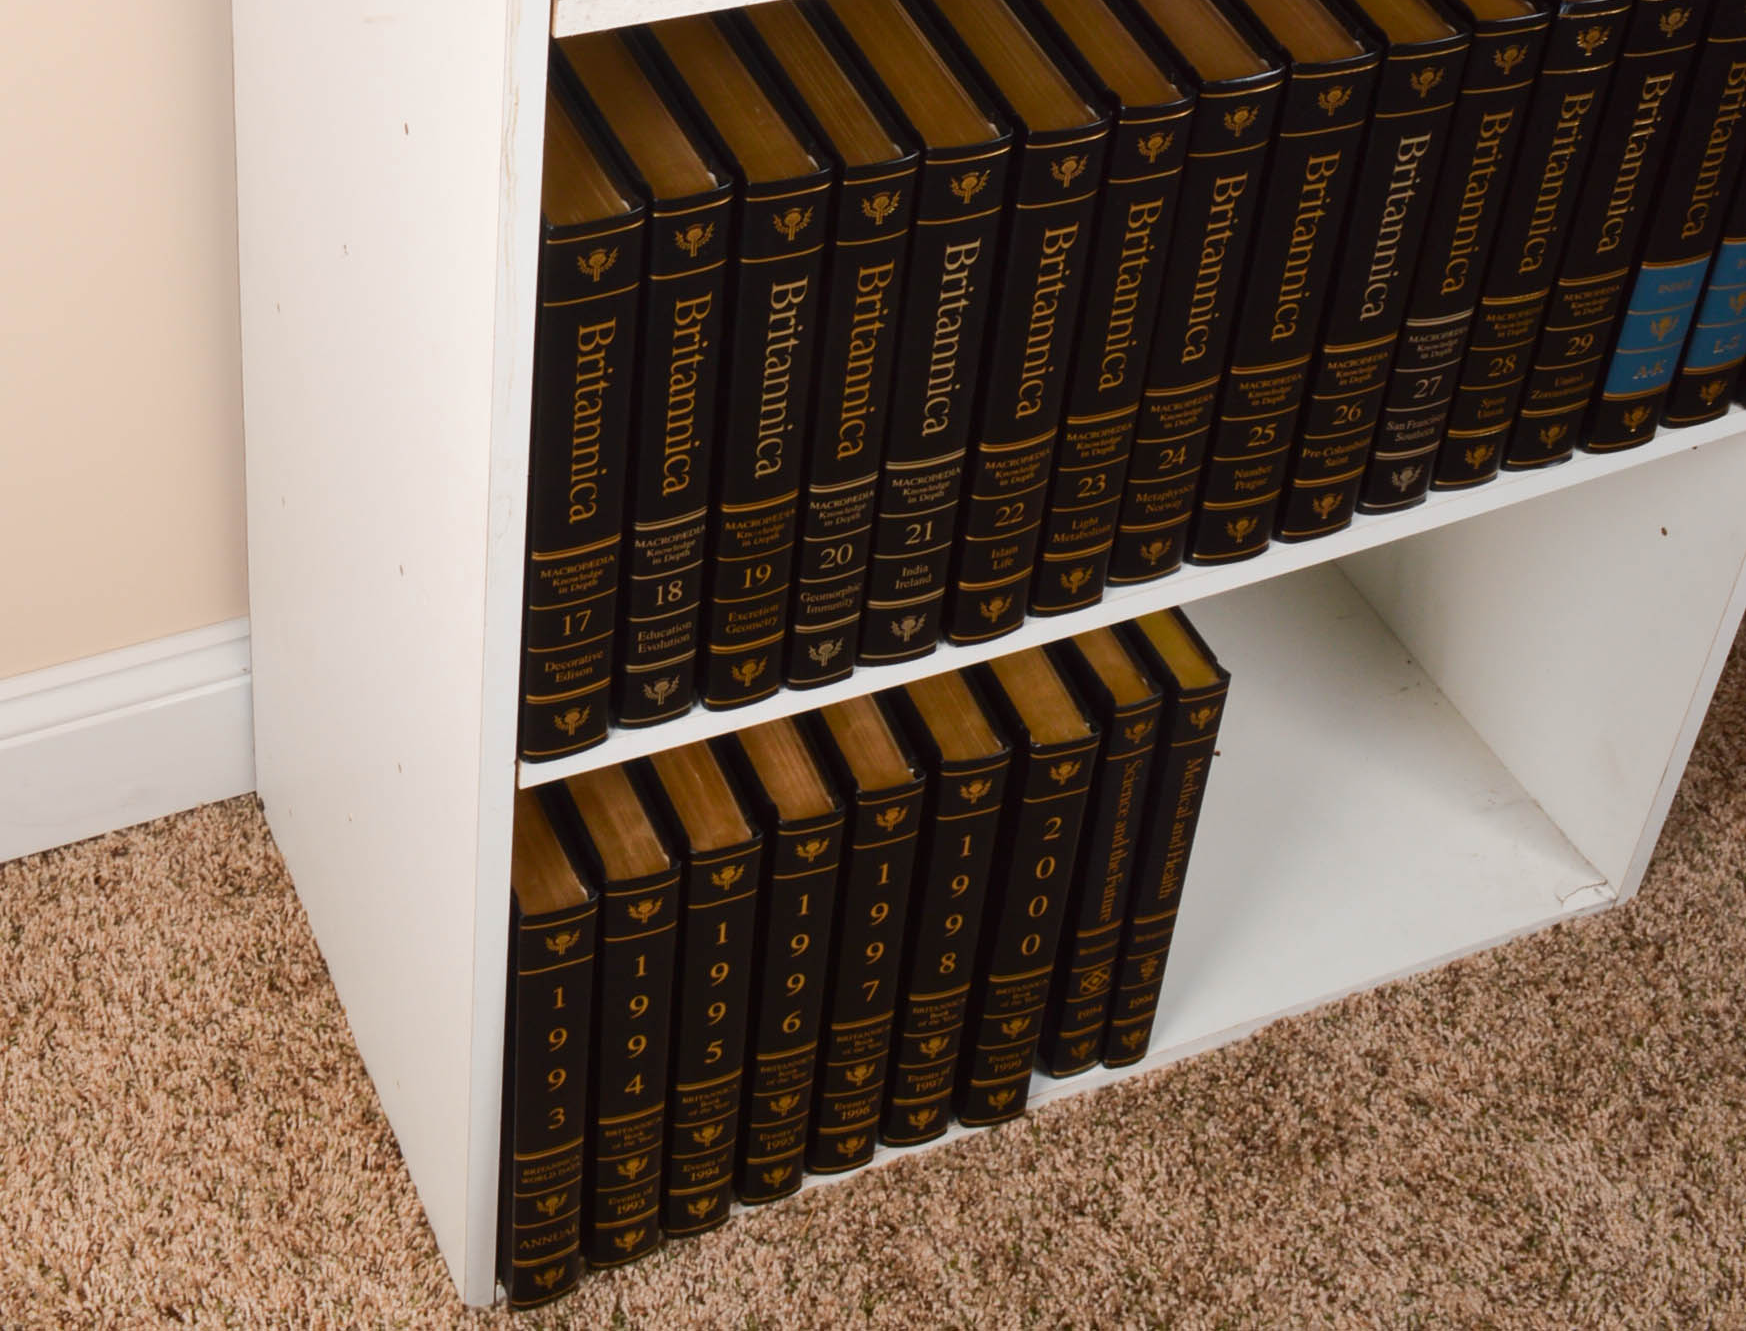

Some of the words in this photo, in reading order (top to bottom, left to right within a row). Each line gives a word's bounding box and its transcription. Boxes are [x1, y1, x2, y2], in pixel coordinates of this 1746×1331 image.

[1596, 71, 1675, 254] Britannica
[1681, 61, 1746, 240] Britannica
[1519, 90, 1596, 275] Britannica
[1440, 107, 1515, 295] Britannica
[1360, 131, 1432, 321] Britannica
[1270, 150, 1342, 341] Britannica
[1182, 171, 1248, 364] Britannica
[1098, 196, 1163, 392] Britannica
[1015, 221, 1081, 420] Britannica
[921, 237, 981, 437] Britannica
[1565, 333, 1595, 356] 29
[836, 258, 895, 461] Britannica
[1488, 353, 1518, 378] 28
[754, 275, 808, 478] Britannica
[1412, 375, 1443, 399] 27
[662, 291, 713, 497] Britannica
[568, 316, 616, 524] Britannica
[1332, 400, 1364, 425] 26
[1247, 423, 1278, 448] 25
[1158, 445, 1187, 469] 24
[1077, 473, 1107, 499] 23
[994, 502, 1025, 528] 22
[905, 521, 933, 546] 21
[820, 543, 853, 569] 20
[743, 564, 772, 589] 19
[896, 575, 932, 590] Ireland
[902, 564, 929, 578] India
[656, 581, 683, 606] 18
[563, 609, 592, 636] 17
[637, 621, 692, 641] Education
[638, 633, 691, 653] Evolution
[545, 651, 603, 672] Decorative
[555, 667, 593, 683] Edison
